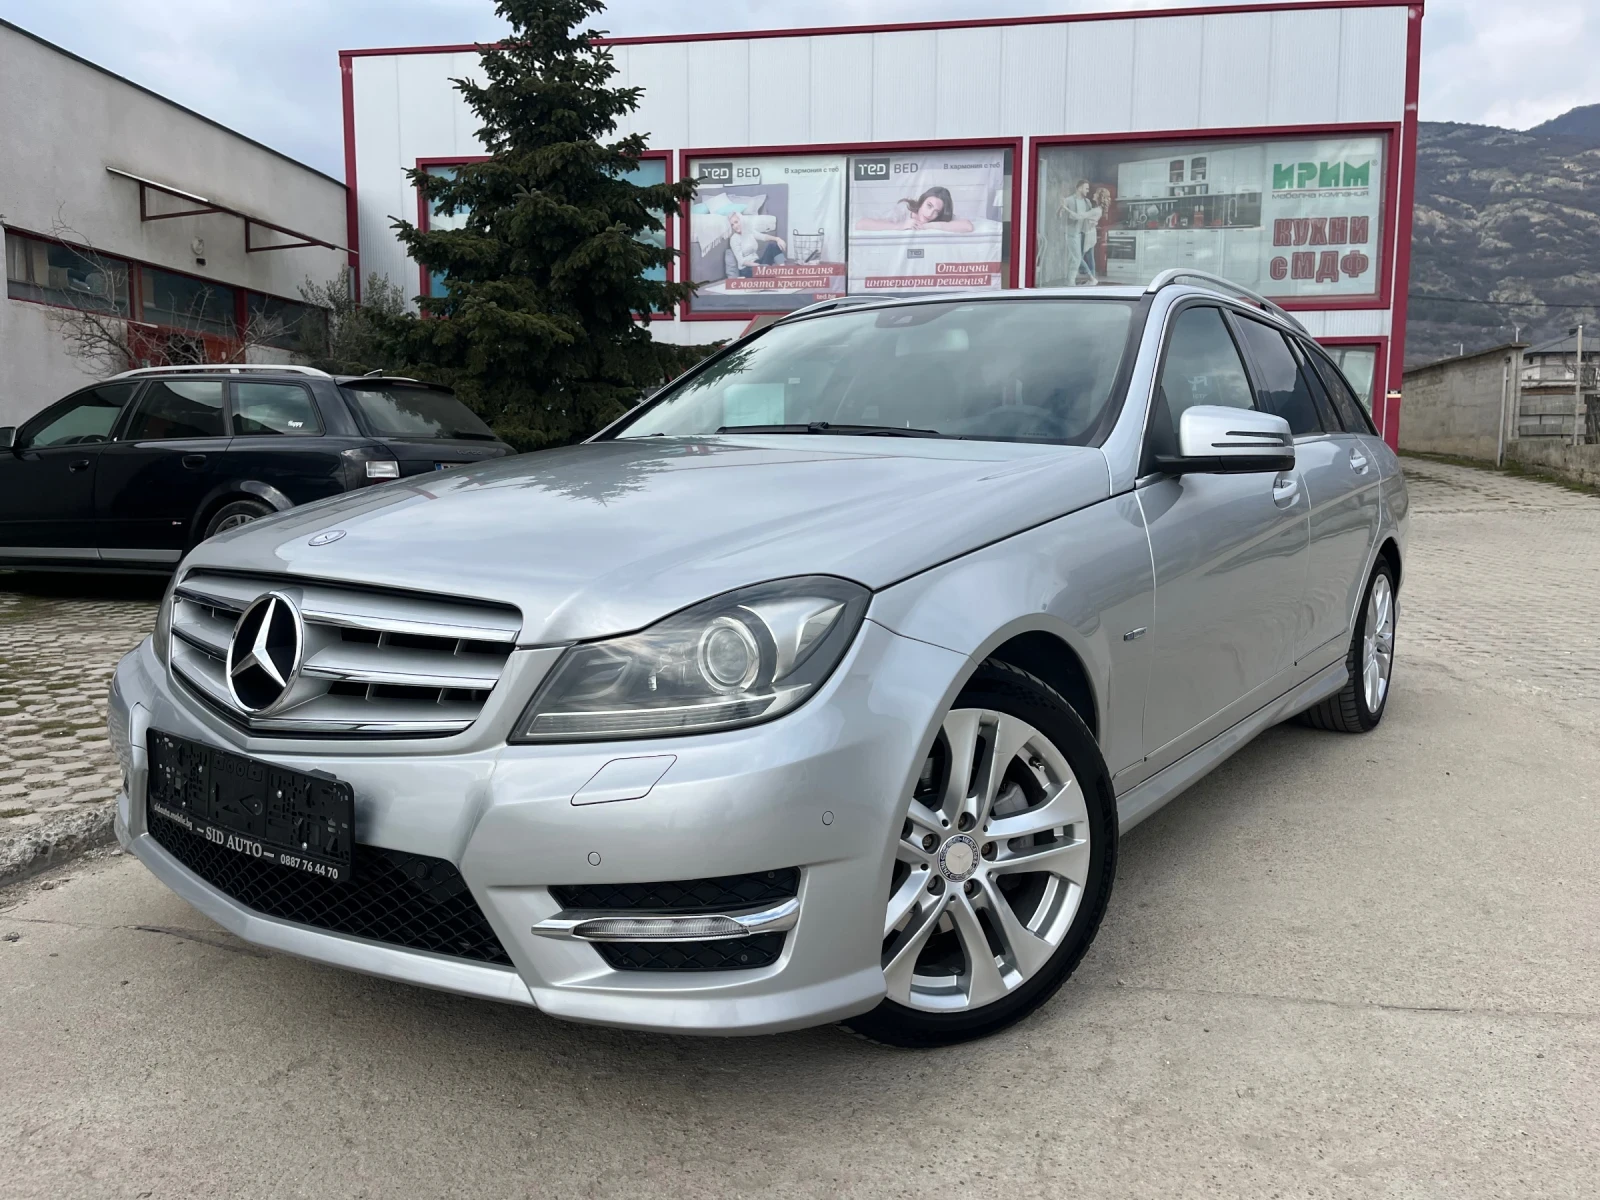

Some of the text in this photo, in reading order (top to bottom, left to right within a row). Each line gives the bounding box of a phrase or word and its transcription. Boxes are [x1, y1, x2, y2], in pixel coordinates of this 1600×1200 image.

[737, 168, 760, 178] BED
[894, 163, 918, 174] BED
[1273, 160, 1370, 189] ИРИМ
[1273, 215, 1369, 247] КУХНИ
[755, 265, 834, 276] Моята спалня
[937, 263, 989, 273] Отлични
[738, 280, 775, 289] моята
[777, 278, 826, 289] крепост!
[866, 275, 988, 288] интериорни решения!
[205, 826, 262, 858] SID AUTO
[280, 853, 338, 879] 0887 76 44 70
